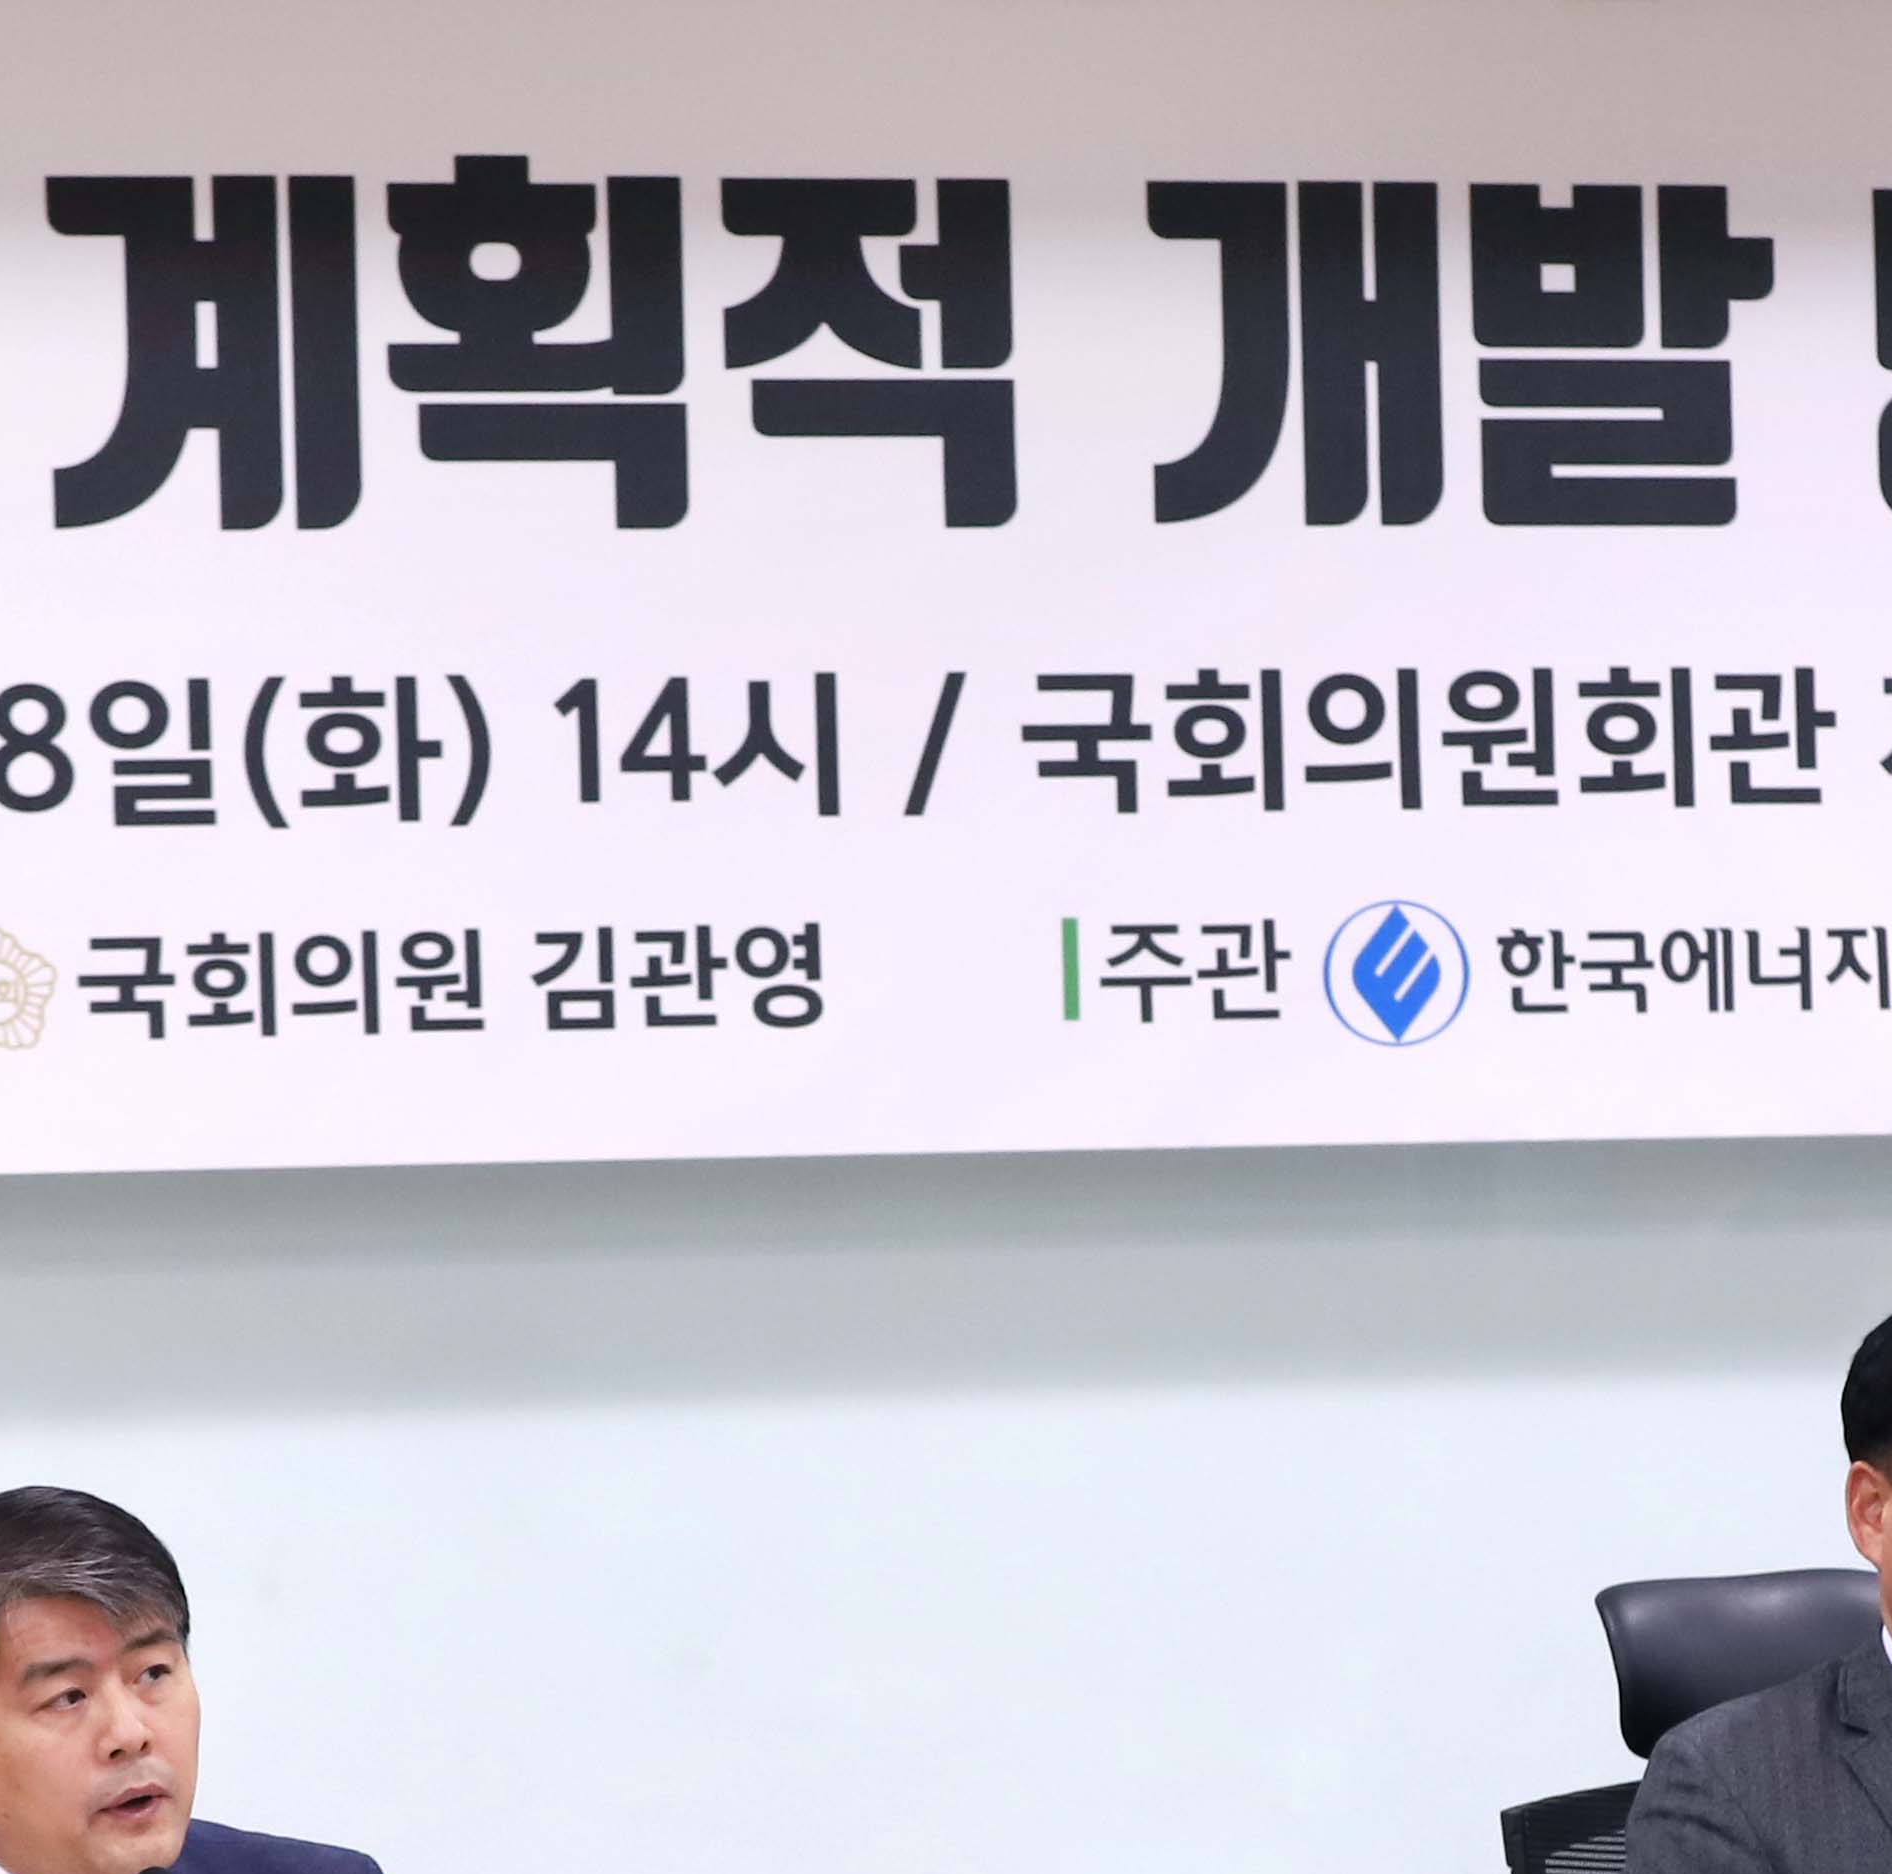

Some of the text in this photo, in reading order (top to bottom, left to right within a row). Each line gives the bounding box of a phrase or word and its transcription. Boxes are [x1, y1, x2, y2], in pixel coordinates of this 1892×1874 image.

[43, 153, 1019, 531] 계획적
[1144, 179, 1776, 527] 개발
[554, 672, 841, 817] 14시
[904, 671, 966, 817] /
[1021, 666, 1837, 814] 국회의원회관
[77, 928, 485, 1040] 국회의원
[531, 922, 824, 1031] 김관영
[1099, 918, 1291, 1023] 주관
